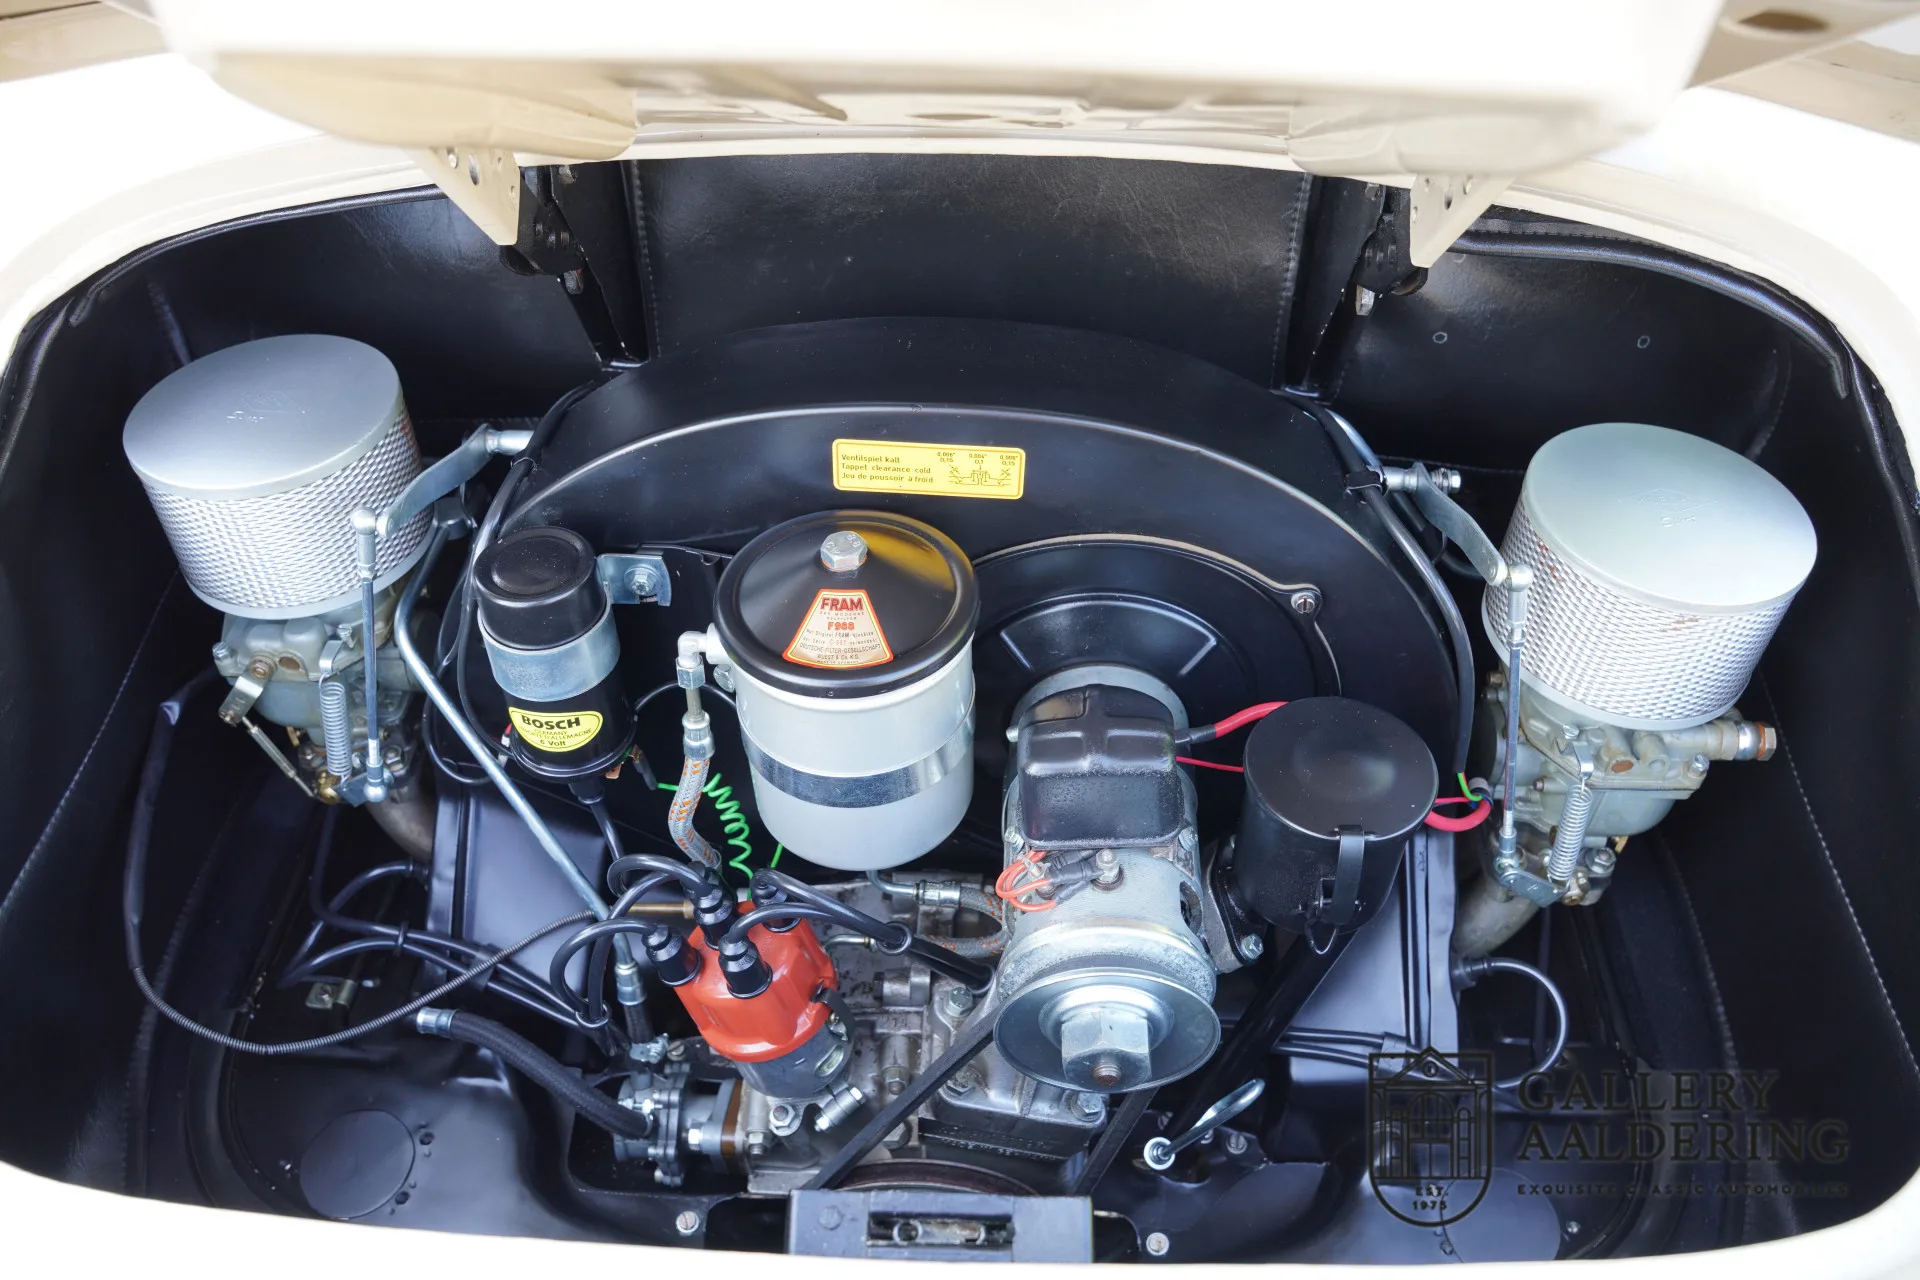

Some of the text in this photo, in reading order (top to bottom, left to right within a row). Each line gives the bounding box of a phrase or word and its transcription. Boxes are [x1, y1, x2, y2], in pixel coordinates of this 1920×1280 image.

[841, 454, 882, 463] Ventilspiel
[820, 597, 864, 611] FRAM
[521, 714, 581, 730] BOSCH
